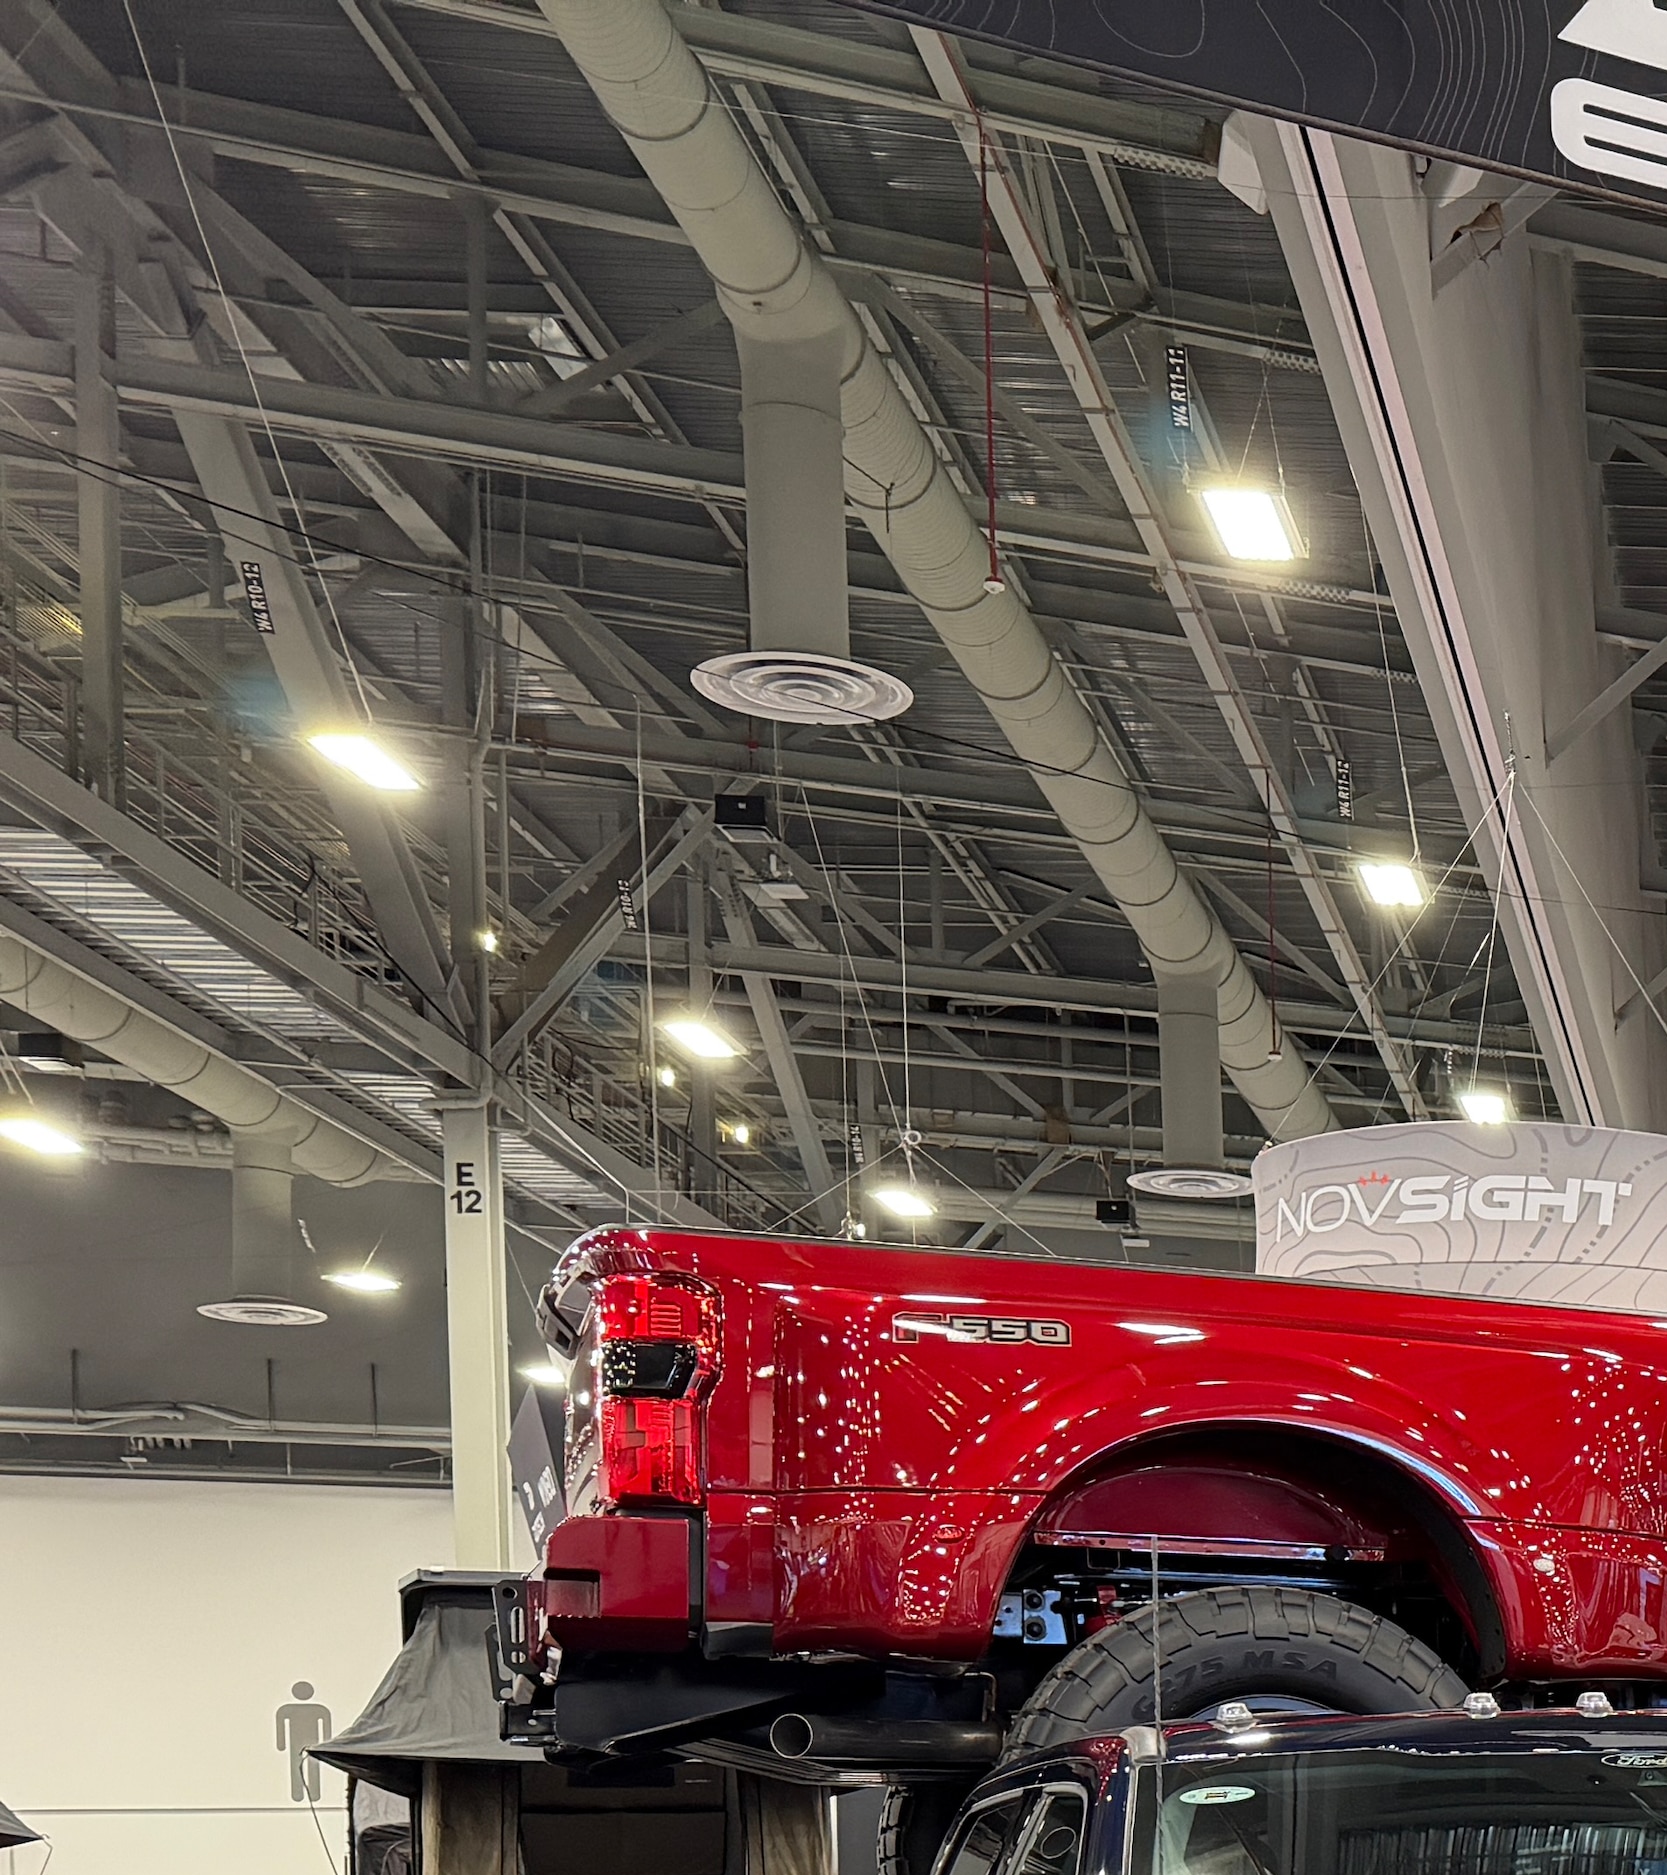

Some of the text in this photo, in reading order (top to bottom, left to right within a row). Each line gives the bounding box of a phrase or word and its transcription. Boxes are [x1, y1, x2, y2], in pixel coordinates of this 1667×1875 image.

[1172, 405, 1189, 427] W4
[456, 1162, 475, 1187] E
[450, 1189, 483, 1213] 12
[1277, 1175, 1624, 1242] NOVSIGHT
[892, 1311, 1072, 1348] F-550
